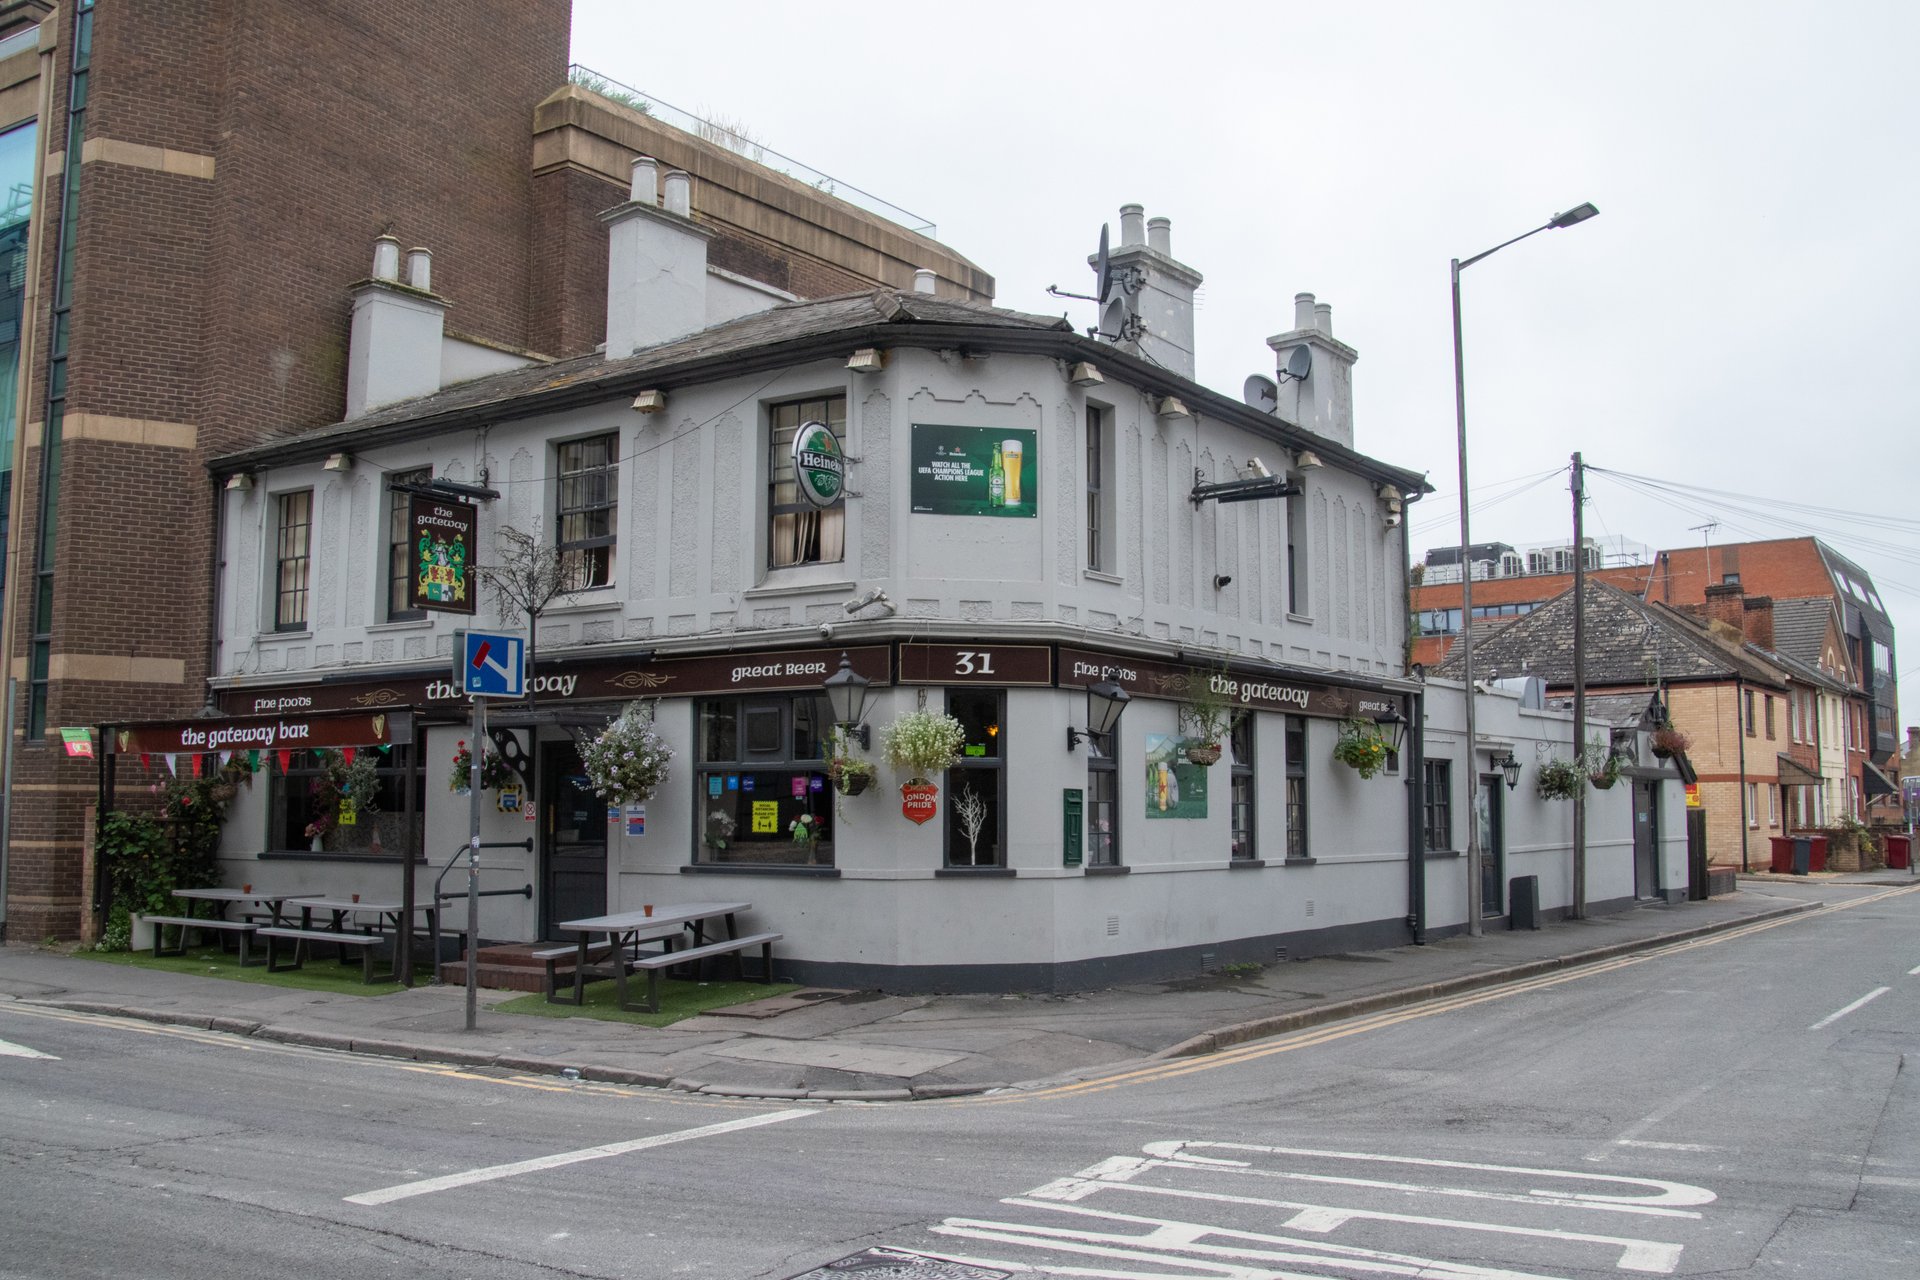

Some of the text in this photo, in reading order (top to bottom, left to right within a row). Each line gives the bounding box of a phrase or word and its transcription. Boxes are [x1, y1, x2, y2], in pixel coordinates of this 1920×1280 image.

[803, 453, 842, 473] Heinek
[434, 507, 453, 518] the
[417, 515, 469, 532] gateway
[955, 651, 995, 675] 31
[1073, 661, 1099, 678] fine
[1209, 674, 1310, 709] the gateway
[254, 697, 312, 712] fine foods
[181, 721, 309, 749] the gateway bar
[903, 793, 938, 802] LONDON
[907, 801, 932, 809] PRIDE
